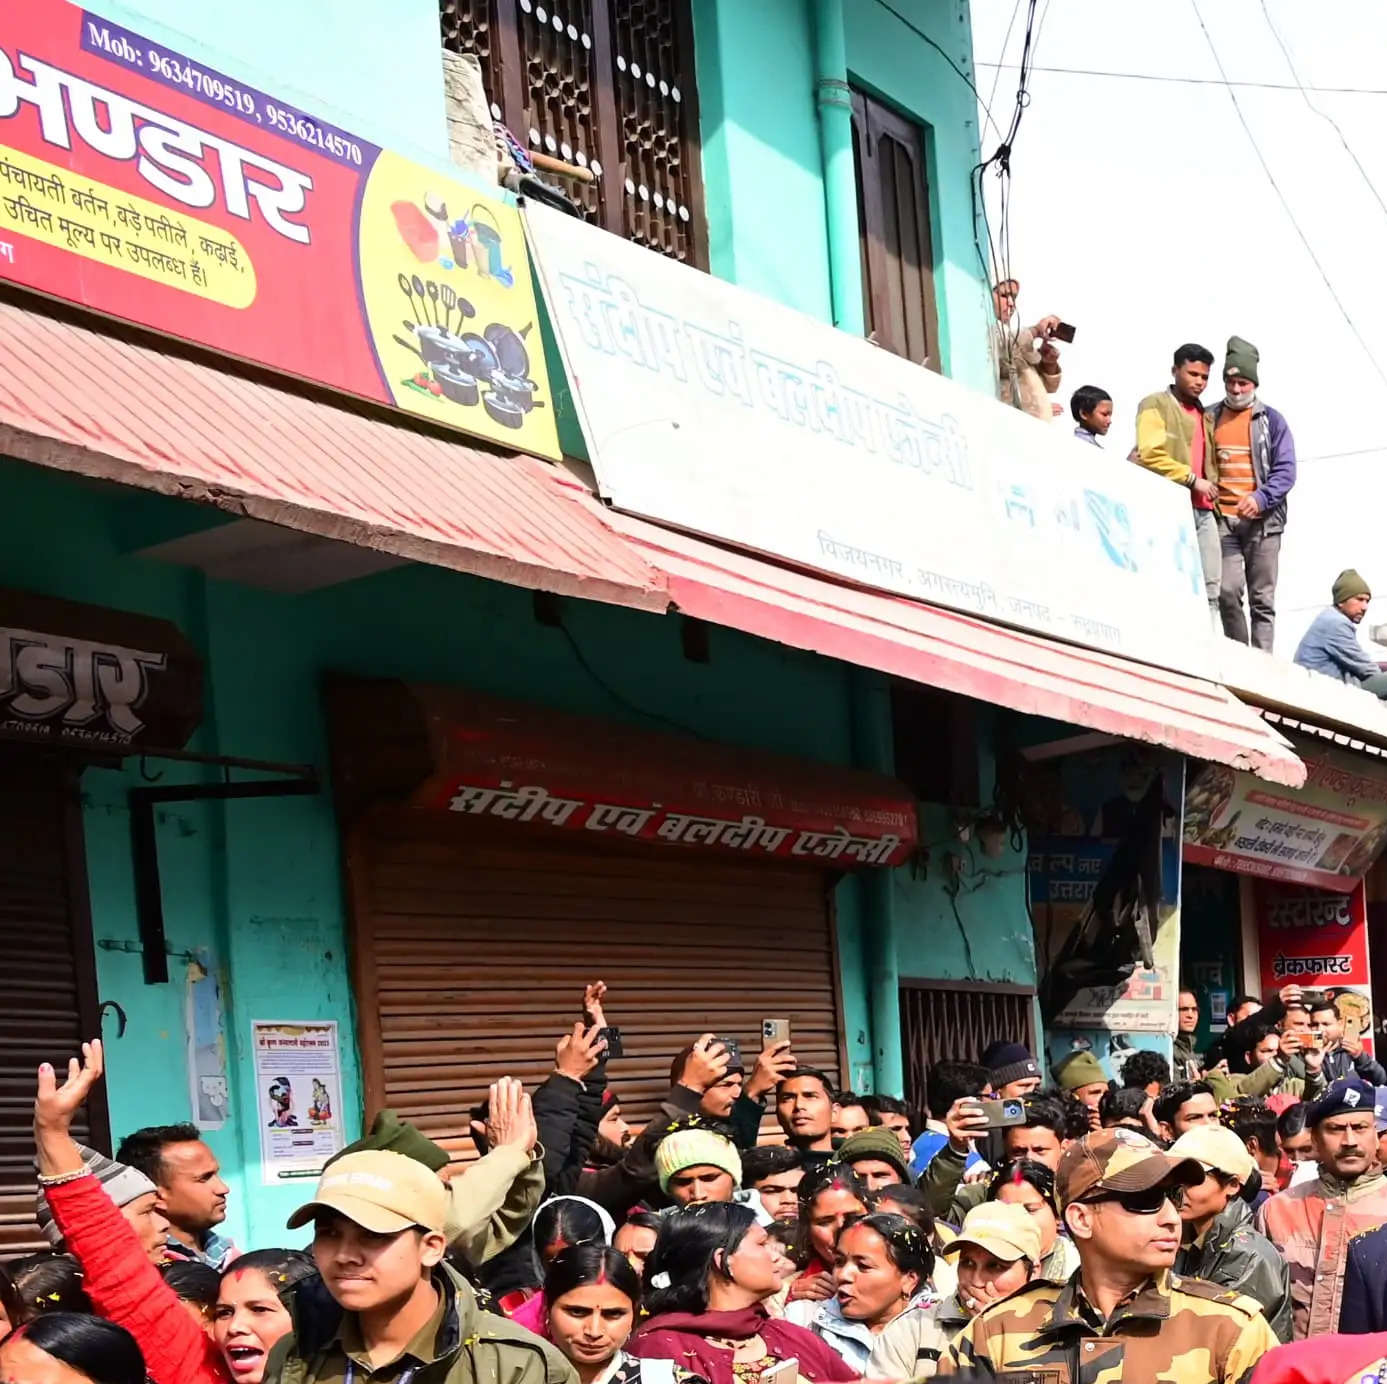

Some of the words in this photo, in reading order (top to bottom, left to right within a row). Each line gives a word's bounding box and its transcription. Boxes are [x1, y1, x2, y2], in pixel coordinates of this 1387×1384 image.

[87, 22, 143, 66] Mob:
[148, 49, 263, 122] 9634709519,
[266, 105, 364, 166] 9536214570
[0, 157, 66, 204] पंचायती
[3, 194, 55, 234] उचित
[58, 215, 97, 249] मूल्य
[100, 229, 123, 258] पर
[449, 778, 583, 828] संदीप
[584, 801, 663, 838] एवं
[656, 810, 794, 856] बलदीप
[790, 824, 908, 866] एजेन्सी
[1272, 950, 1353, 980] ब्रेकफास्ट
